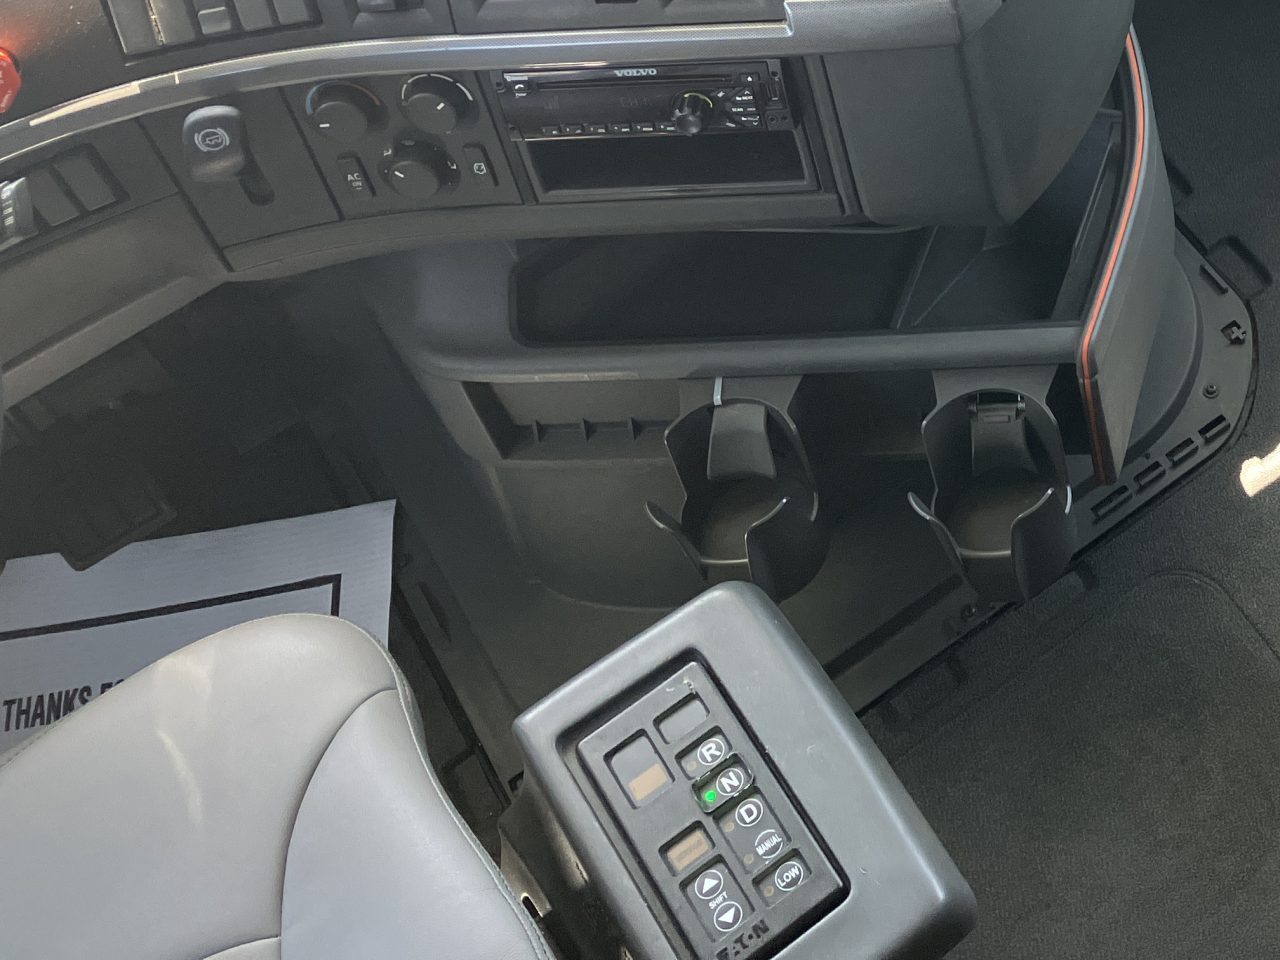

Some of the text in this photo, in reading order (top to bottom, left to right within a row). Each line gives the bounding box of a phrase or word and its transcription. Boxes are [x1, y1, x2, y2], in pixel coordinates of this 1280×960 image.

[614, 68, 657, 77] VOLVO
[347, 172, 361, 181] AC
[3, 685, 92, 732] THANKS
[700, 741, 721, 762] R
[719, 771, 740, 793] N
[739, 803, 758, 824] D
[755, 833, 783, 855] MANUAL
[777, 866, 800, 887] LOW
[708, 891, 728, 910] SHIFT
